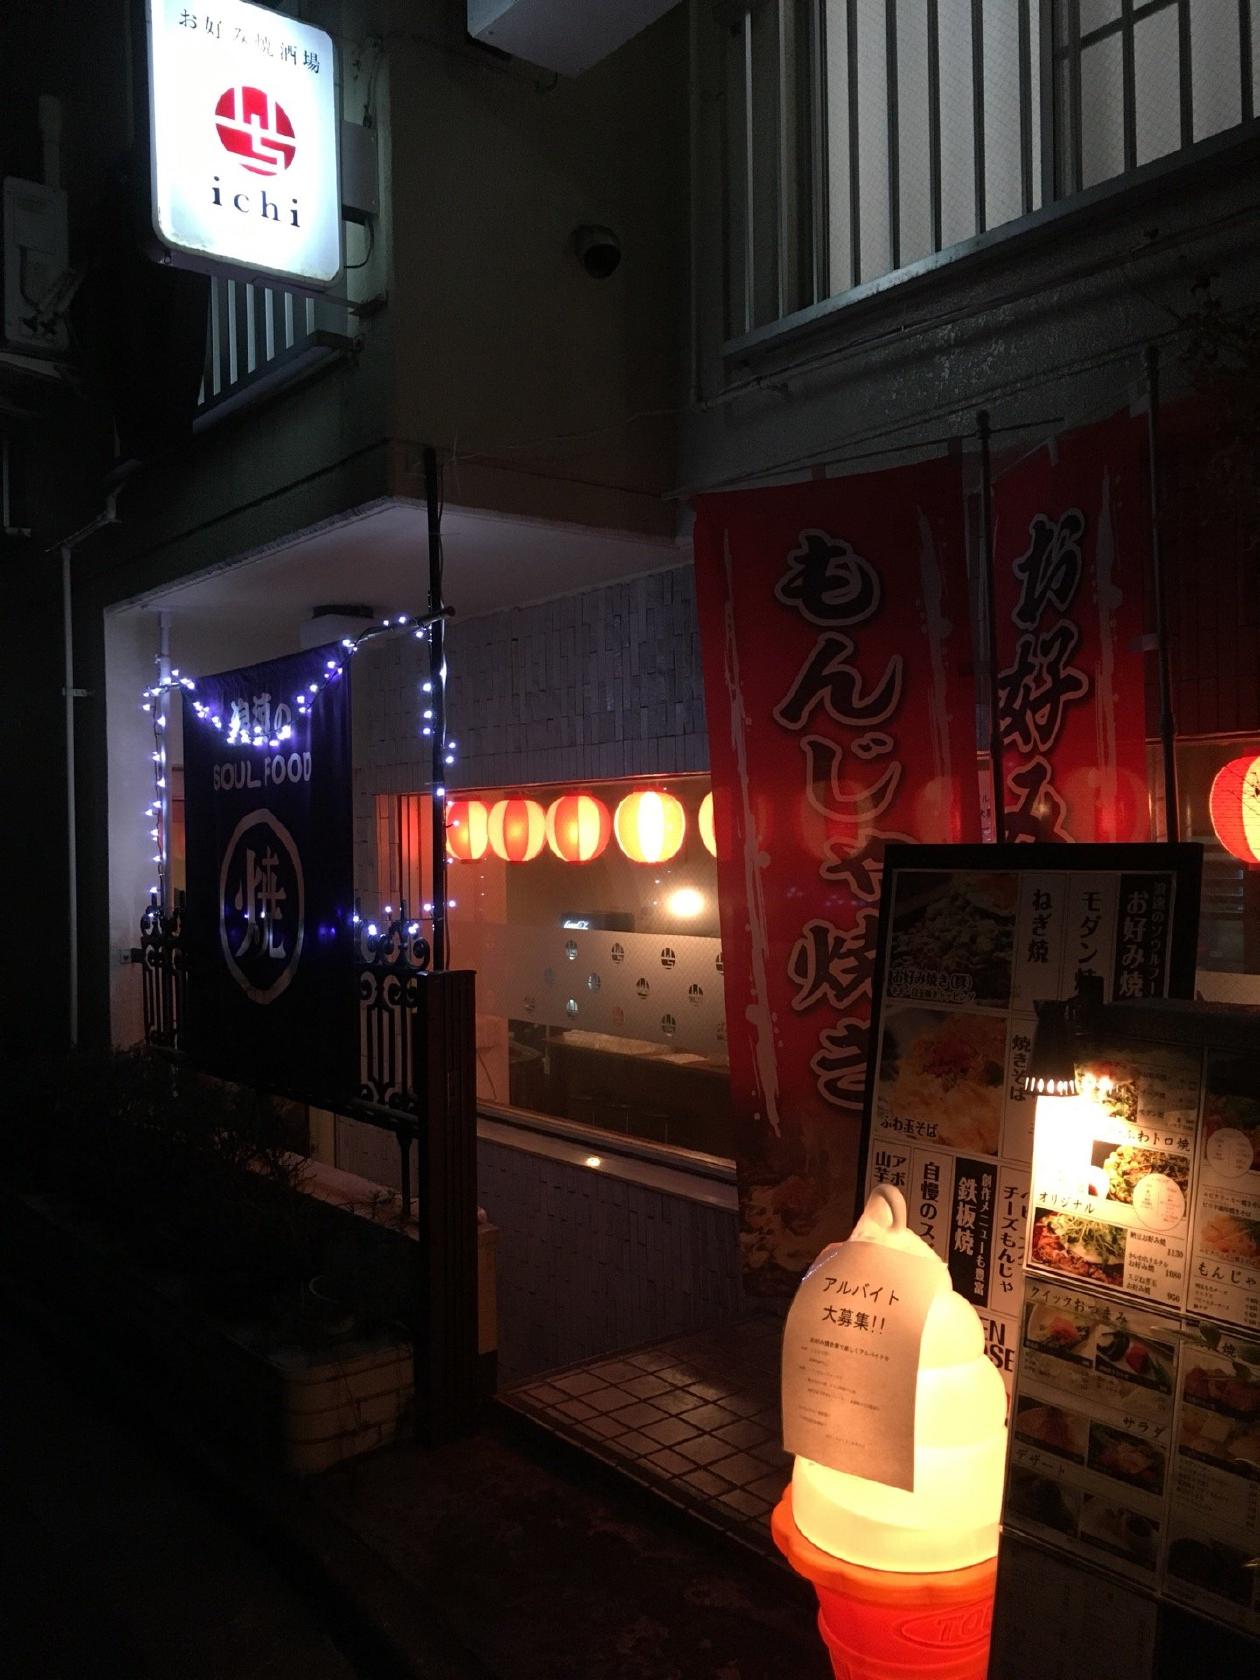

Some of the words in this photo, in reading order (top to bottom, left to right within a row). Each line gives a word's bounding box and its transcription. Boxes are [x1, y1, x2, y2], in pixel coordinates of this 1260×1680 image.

[179, 9, 321, 74] お好み焼酒場
[211, 176, 301, 227] ichi
[212, 761, 260, 791] SOUL
[264, 751, 314, 788] FOOD
[1027, 888, 1054, 964] ねぎ焼
[1118, 890, 1150, 998] お好み焼
[880, 1115, 939, 1138] ふわ玉そば
[918, 1162, 943, 1249] 自慢のス
[953, 1176, 978, 1257] 鉄板焼
[1038, 1191, 1096, 1214] オリジナル
[997, 1186, 1018, 1293] チーズもんじゃ
[821, 1276, 901, 1307] アルバイト
[1197, 1262, 1257, 1289] もんじゃ
[821, 1305, 887, 1335] 大募集!!
[1123, 1416, 1168, 1438] サラダ
[1015, 1450, 1066, 1475] デザート
